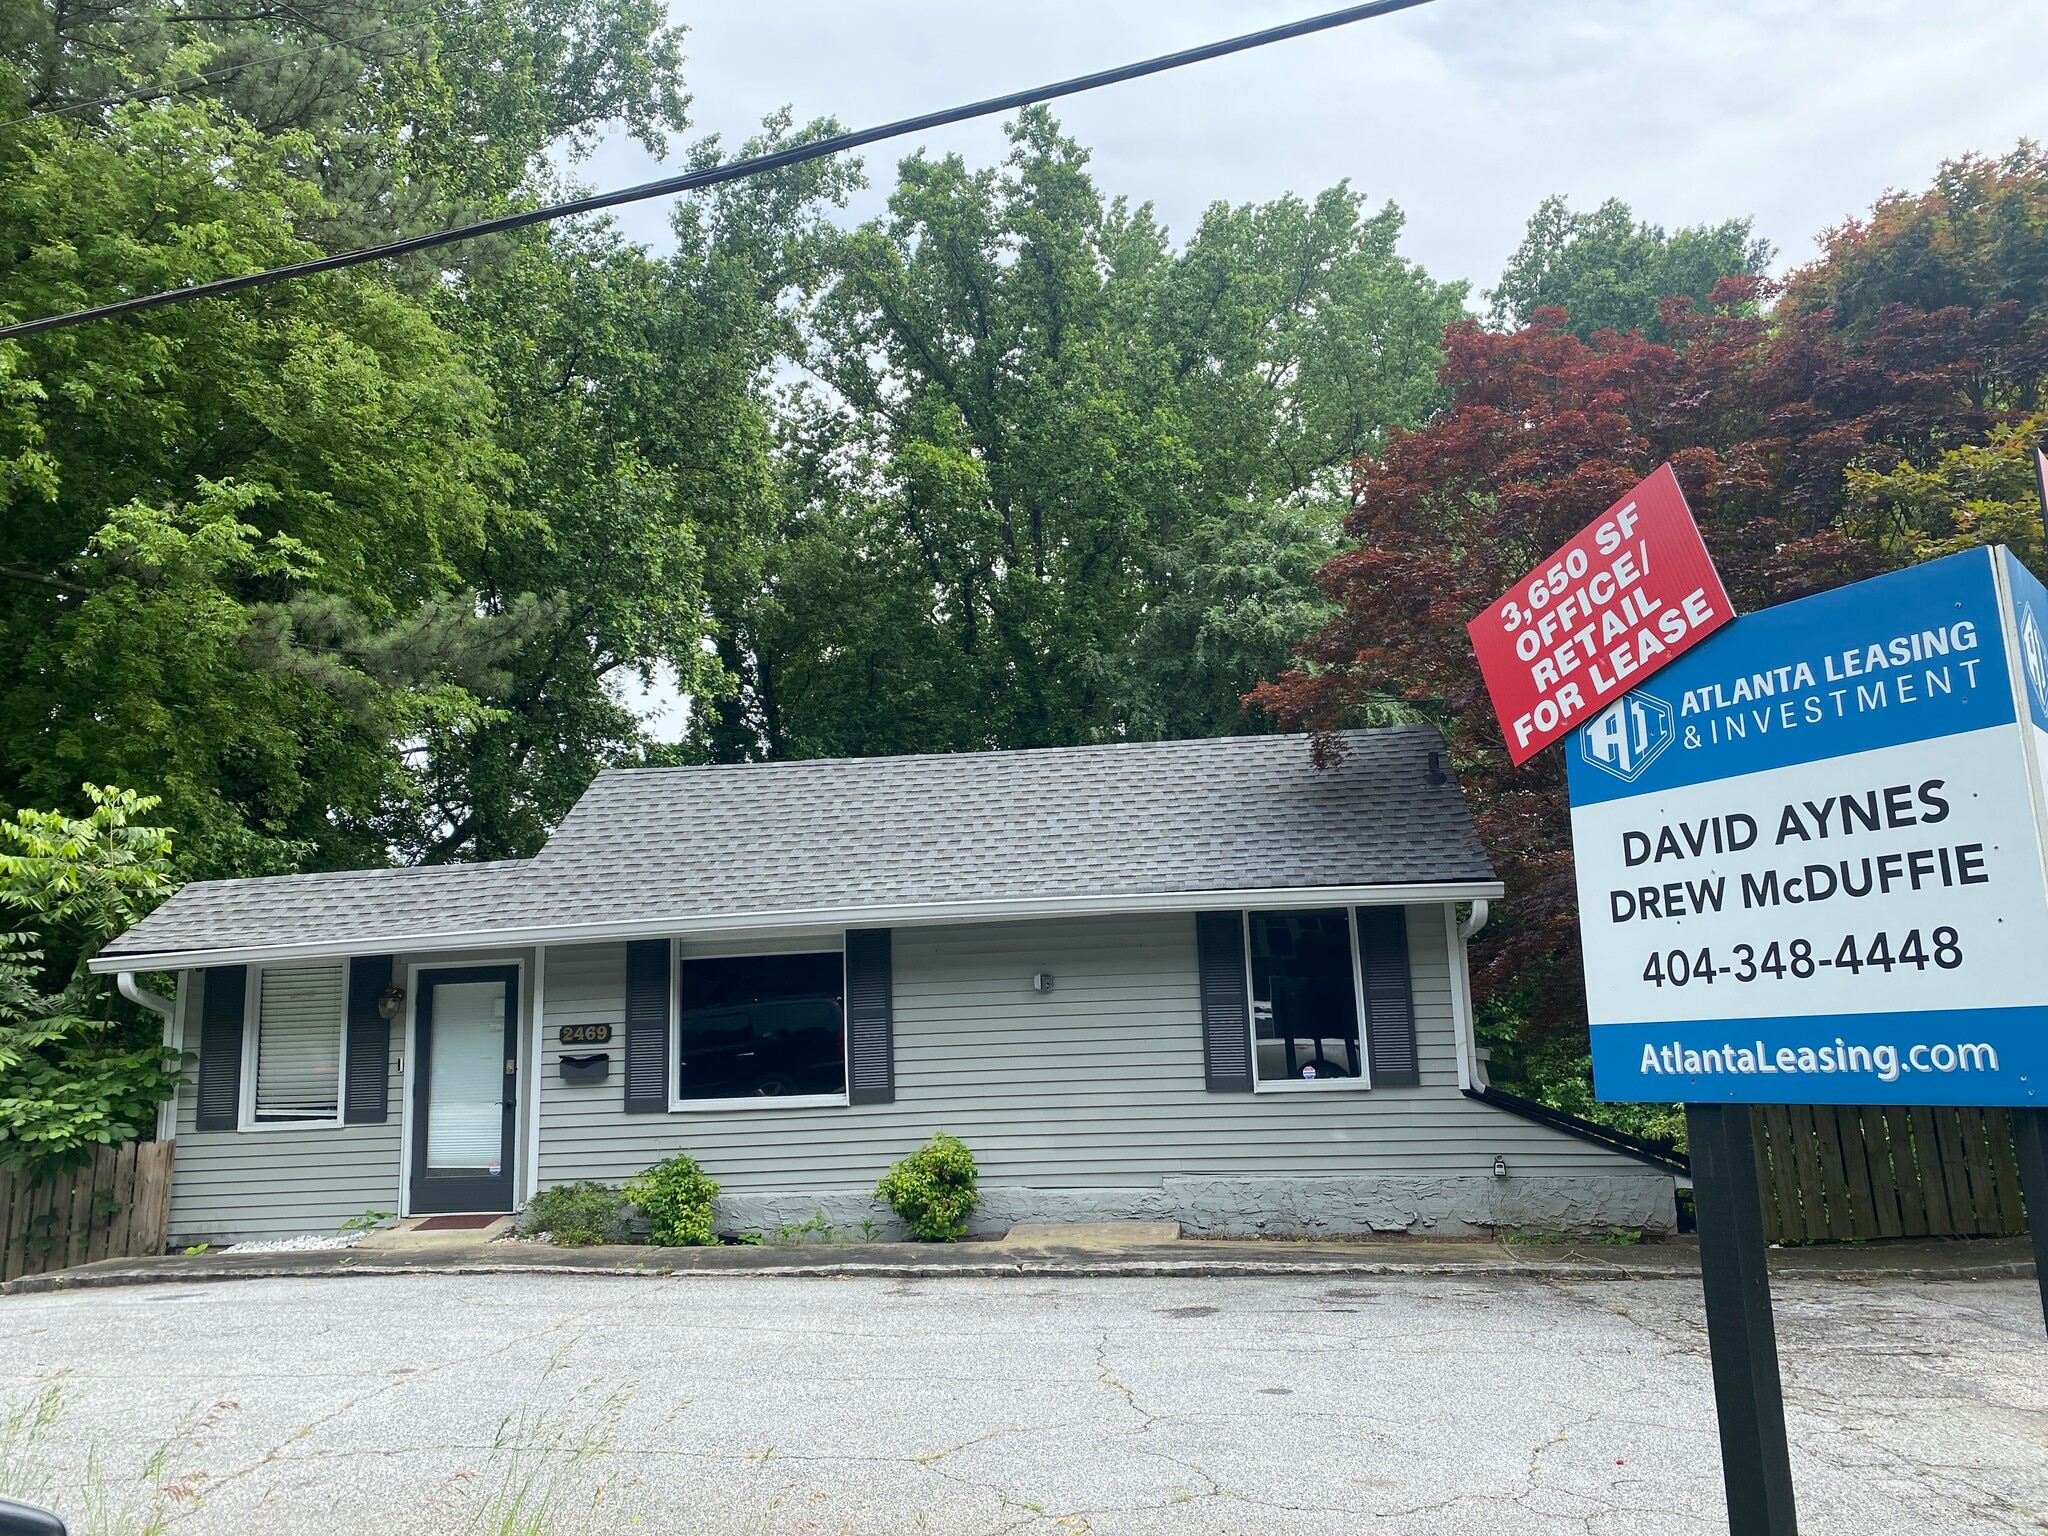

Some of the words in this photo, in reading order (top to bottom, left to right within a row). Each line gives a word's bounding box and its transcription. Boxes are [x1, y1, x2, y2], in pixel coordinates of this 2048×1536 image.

[1501, 548, 1588, 632] 3,650
[1595, 501, 1639, 555] SF
[1516, 539, 1650, 662] OFFICE/
[1513, 682, 1585, 748] FOR
[1588, 587, 1714, 695] LEASE
[1531, 586, 1662, 694] RETAIL
[1681, 662, 1816, 717] ATLANTA
[1824, 620, 1979, 682] LEASING
[1683, 725, 1702, 750] &
[1711, 658, 1981, 744] INVESTMENT
[1623, 813, 1758, 867] DAVID
[1775, 779, 1950, 845] AYNES
[1610, 876, 1726, 923] DREW
[1741, 843, 1989, 909] McDUFFIE
[1642, 926, 1963, 987] 404-348-4448
[562, 1026, 608, 1041] 2469
[1640, 1037, 2000, 1082] AtlantaLeasing.com
